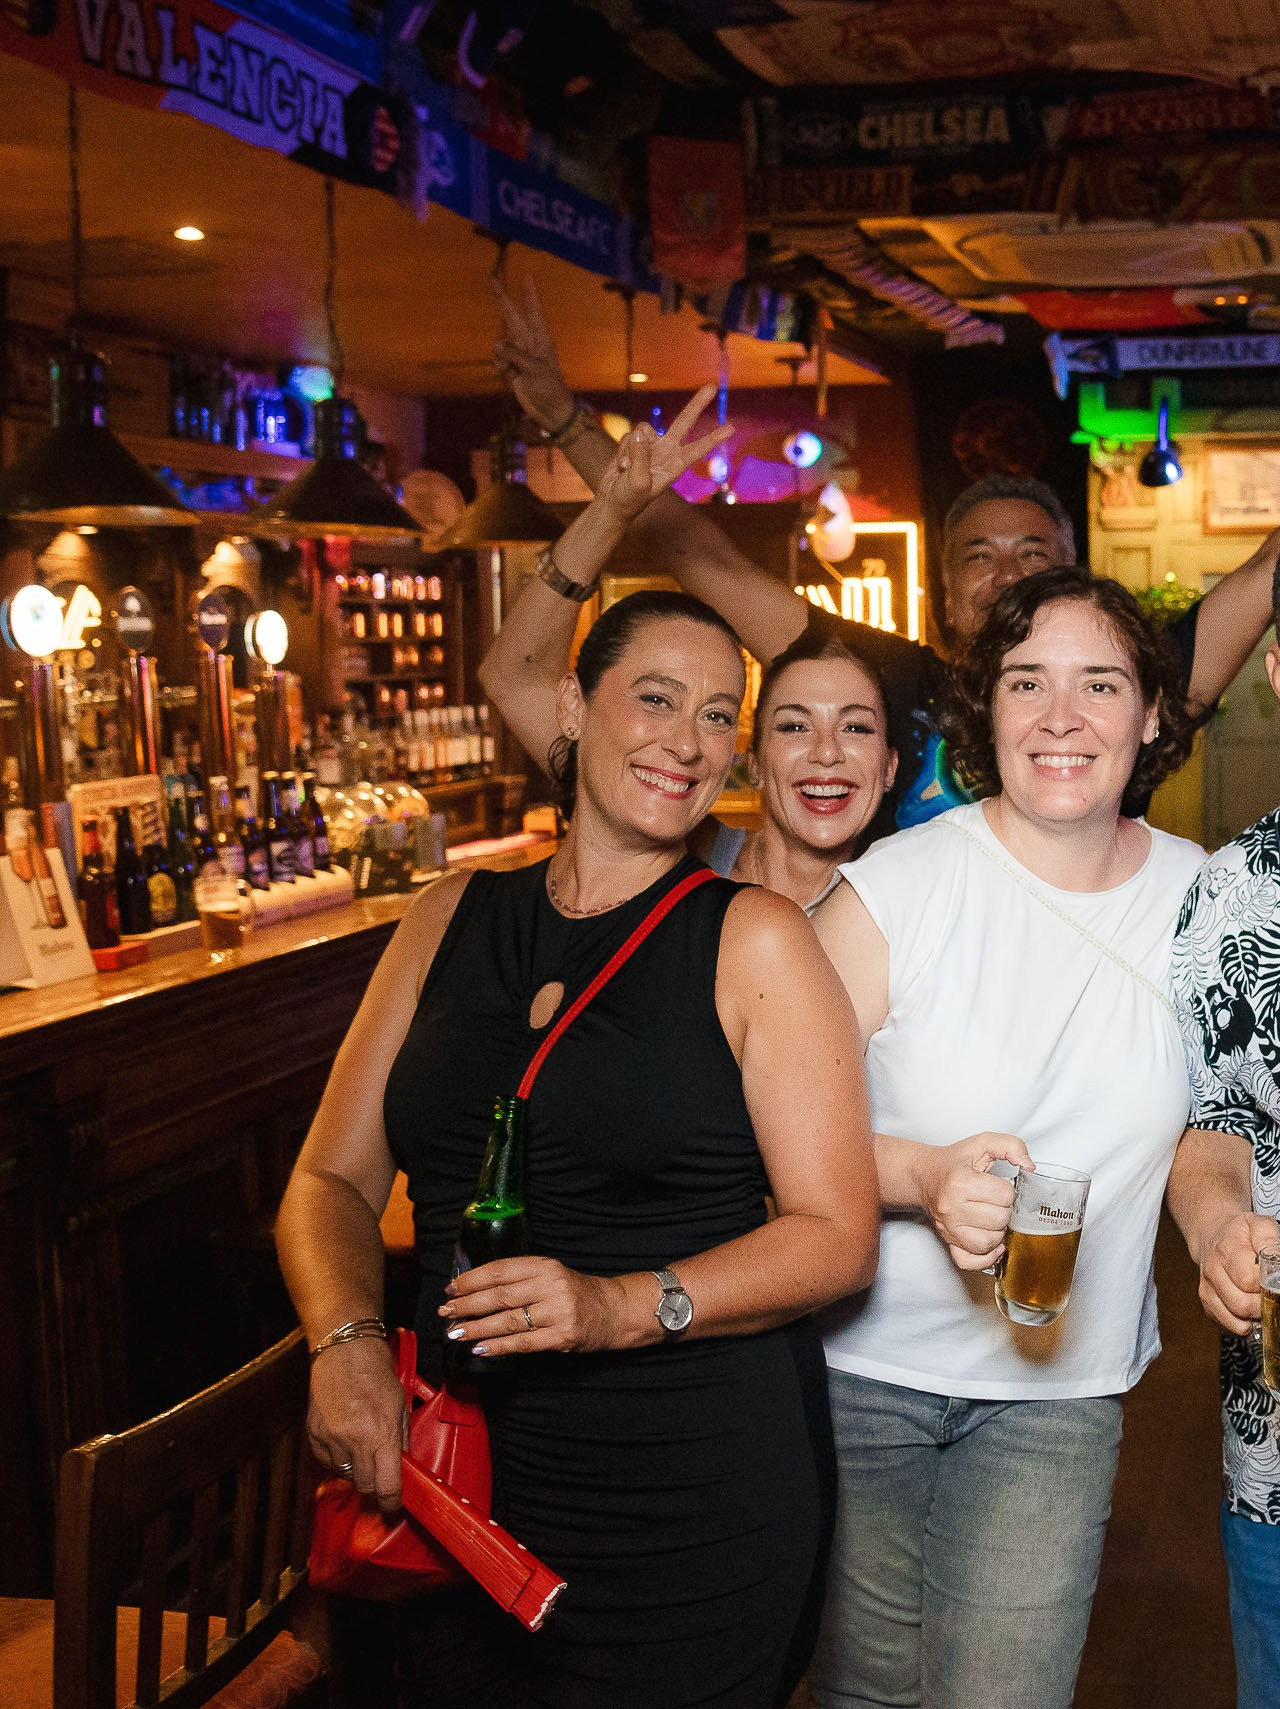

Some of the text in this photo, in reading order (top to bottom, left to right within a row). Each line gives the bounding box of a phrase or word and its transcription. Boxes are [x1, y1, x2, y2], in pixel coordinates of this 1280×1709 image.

[75, 0, 348, 158] VALENCIA
[857, 105, 1012, 150] CHELSEA
[1039, 1205, 1075, 1219] Mahou
